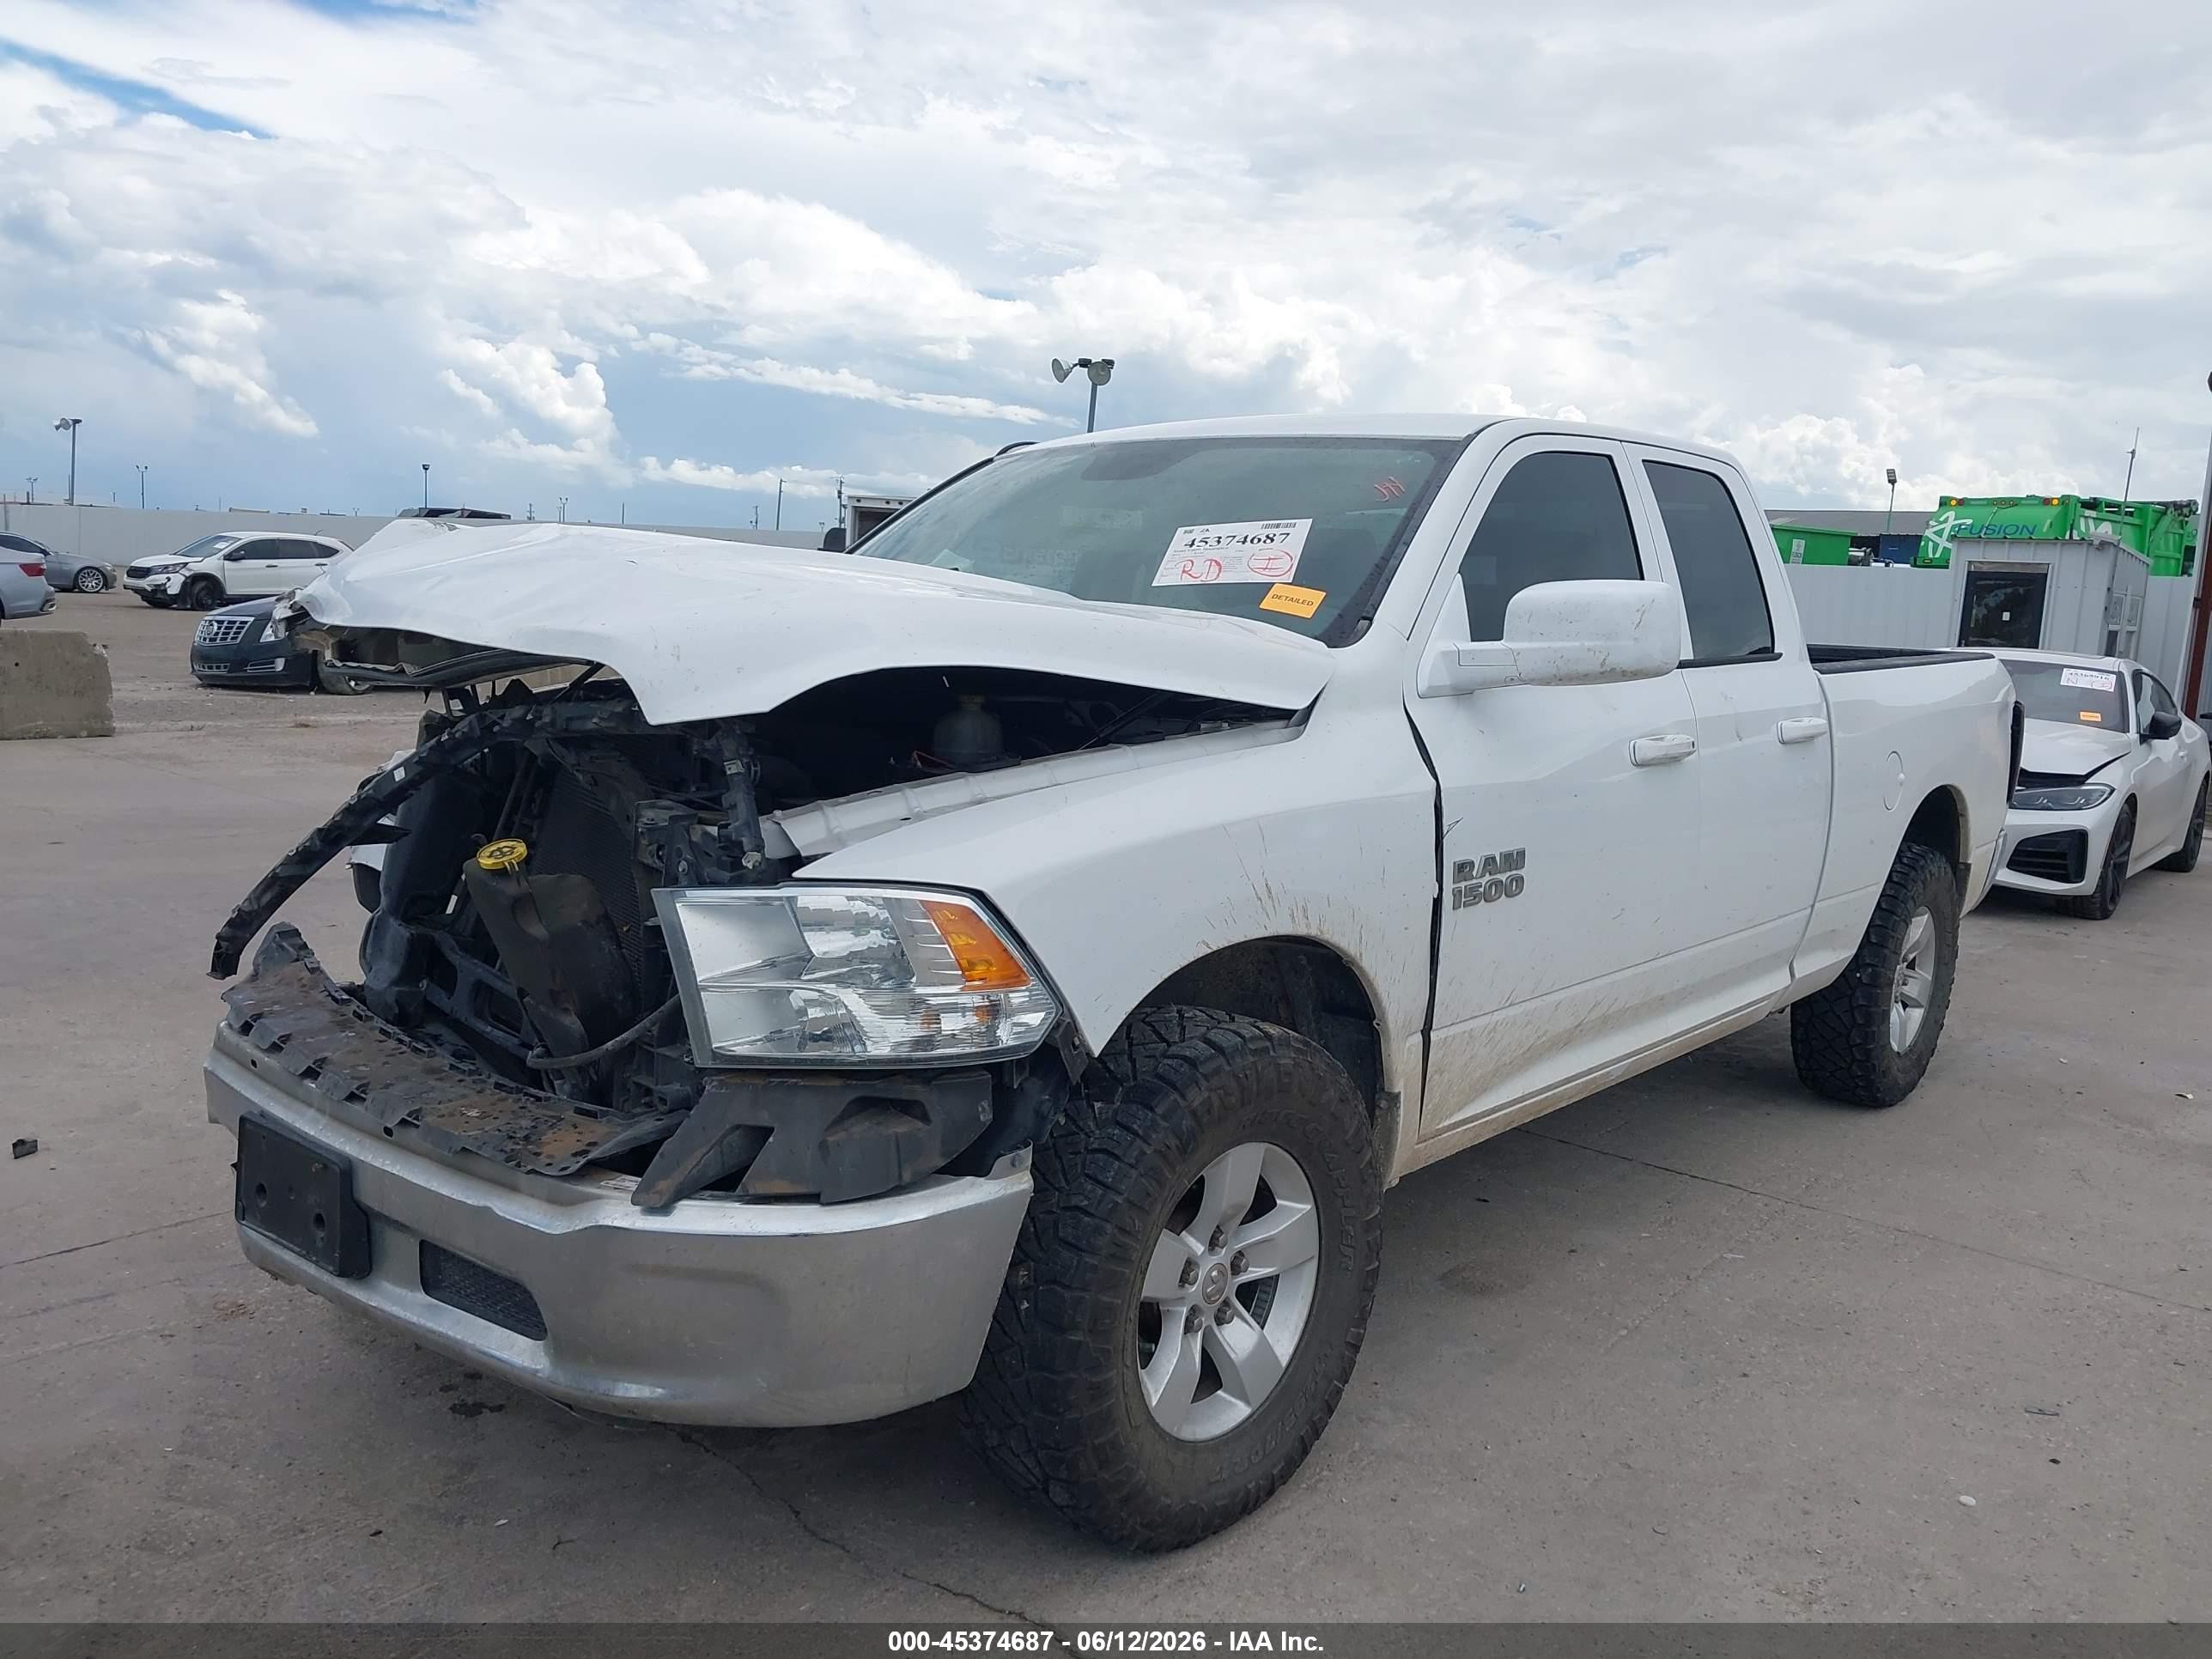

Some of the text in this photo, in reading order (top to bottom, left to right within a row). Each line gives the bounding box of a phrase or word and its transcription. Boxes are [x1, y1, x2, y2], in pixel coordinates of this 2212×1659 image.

[1956, 523, 2037, 536] FUSION
[1184, 532, 1291, 549] 45374687
[1271, 593, 1314, 606] DETAILED
[1452, 848, 1526, 884] RAM
[1452, 873, 1524, 911] 1500
